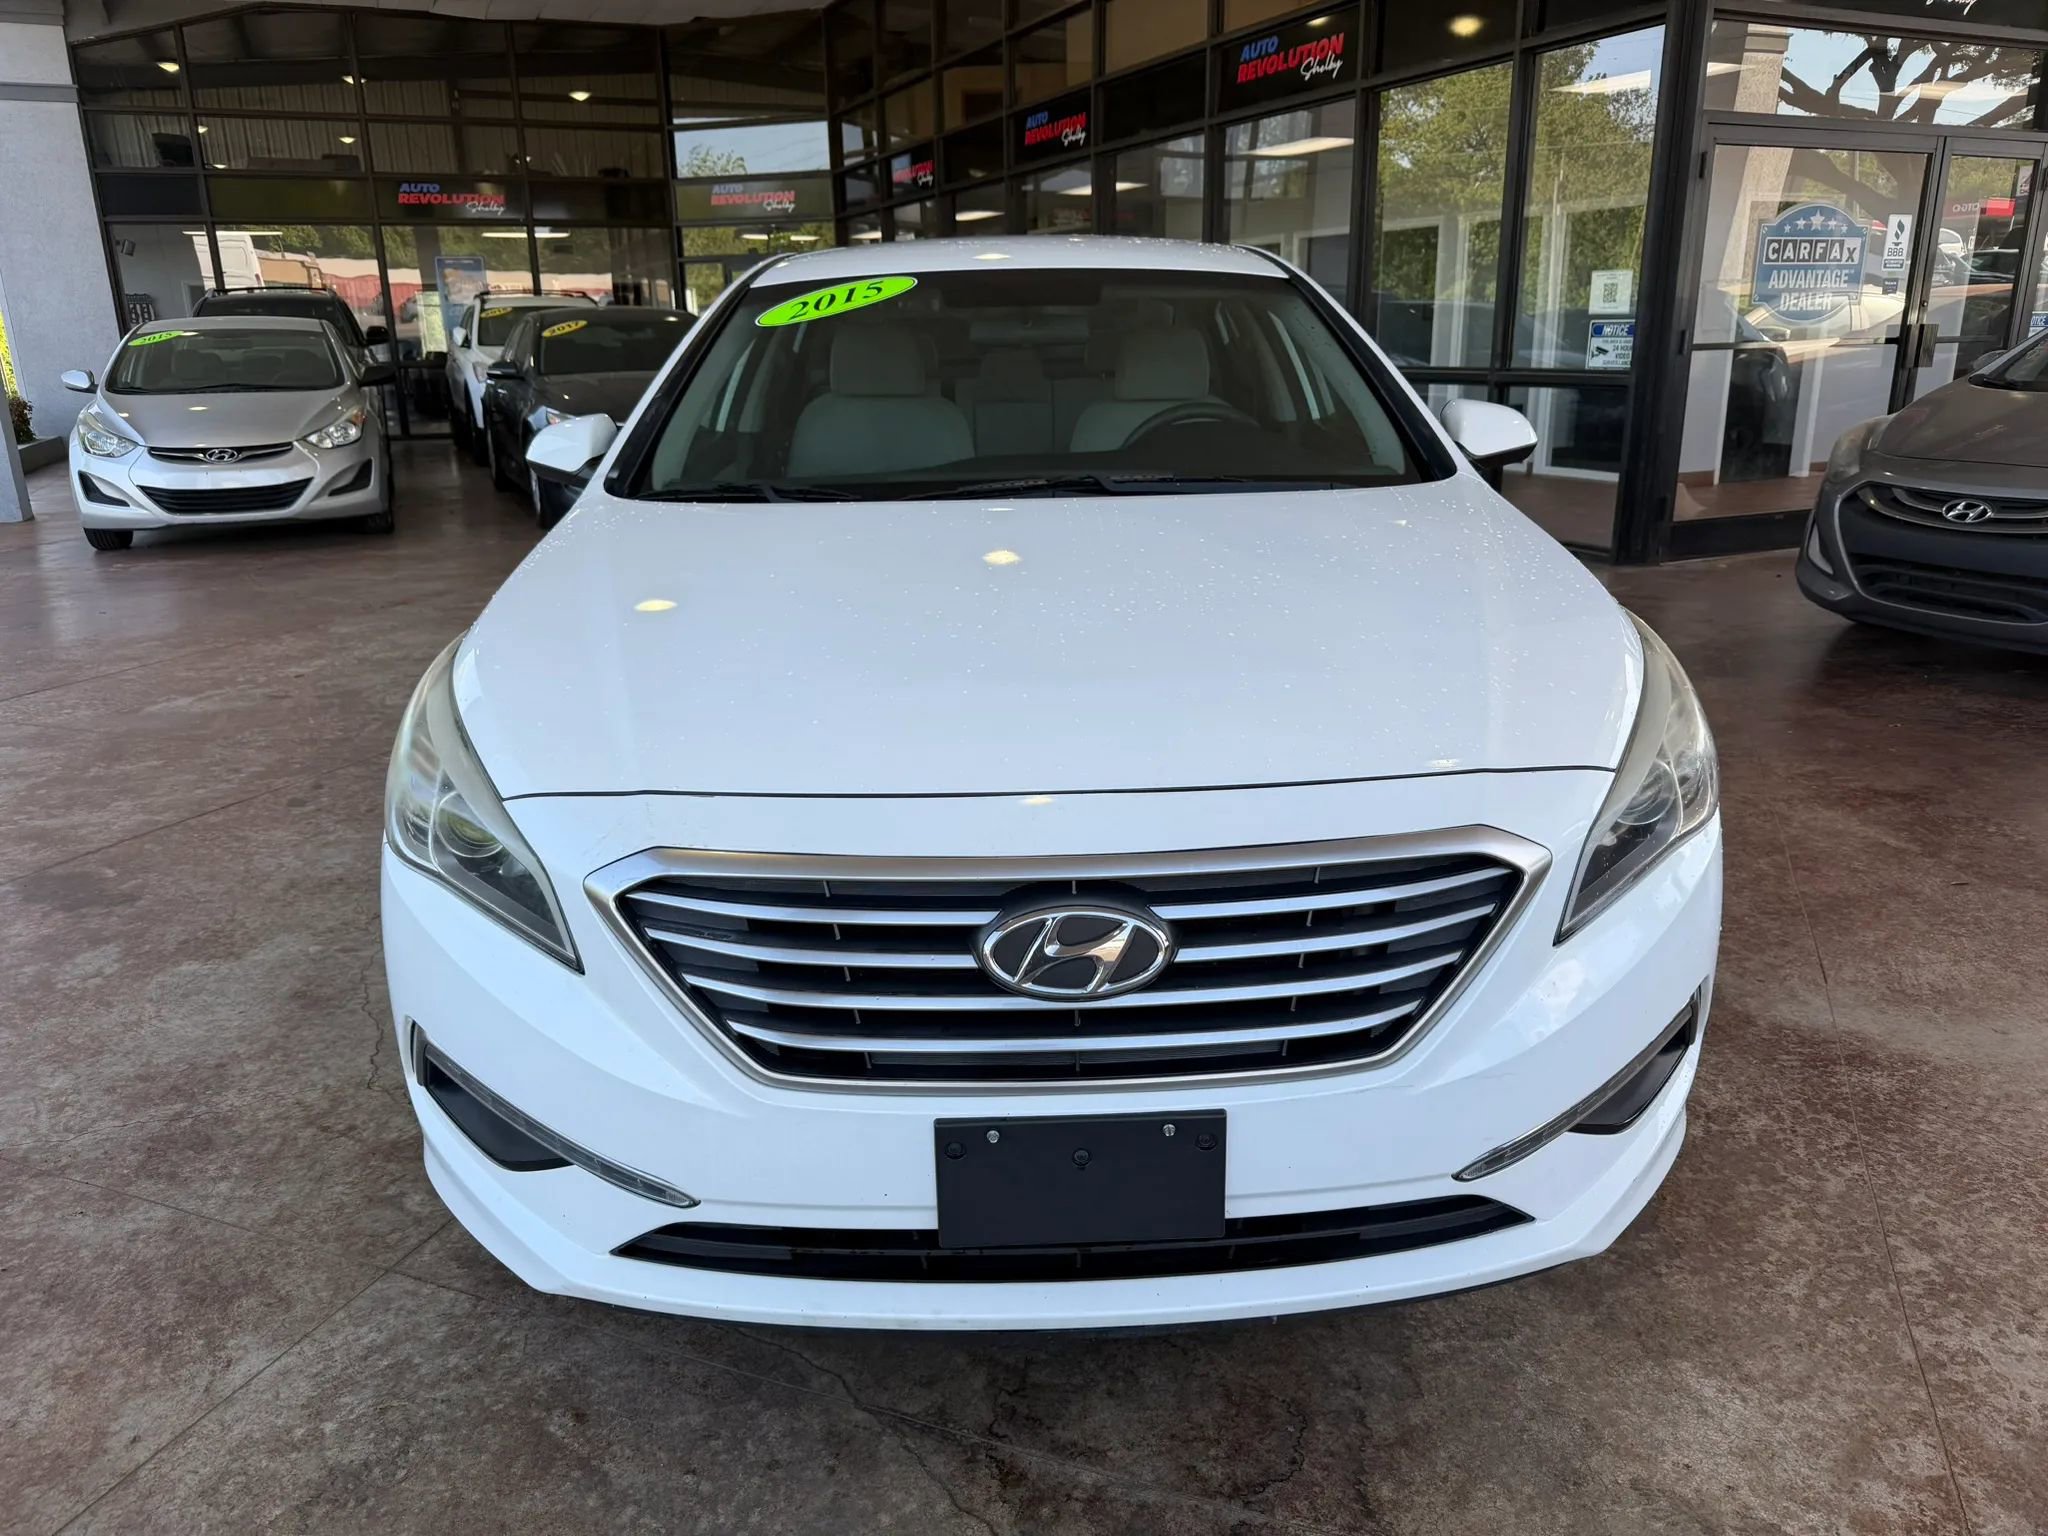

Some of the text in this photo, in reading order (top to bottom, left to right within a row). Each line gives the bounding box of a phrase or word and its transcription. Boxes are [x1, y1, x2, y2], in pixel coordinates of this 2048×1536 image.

[1237, 32, 1344, 84] REVOLUTION
[1241, 35, 1279, 62] AUTO
[1300, 50, 1343, 81] Shelby
[1025, 112, 1086, 146] REVOLUTION
[1026, 111, 1048, 130] AUTO
[399, 183, 440, 193] AUTO
[710, 189, 797, 206] REVOLUTION
[712, 183, 744, 194] AUTO
[397, 192, 506, 205] REVOLUTION
[465, 201, 506, 216] Shelby
[1767, 242, 1857, 263] CARFAX
[1887, 247, 1904, 257] BBB
[1768, 269, 1850, 289] ADVANTAGE
[787, 280, 884, 321] 2015
[1780, 291, 1833, 311] DEALER
[1602, 323, 1629, 336] NOTICE
[2031, 315, 2047, 326] OTICE
